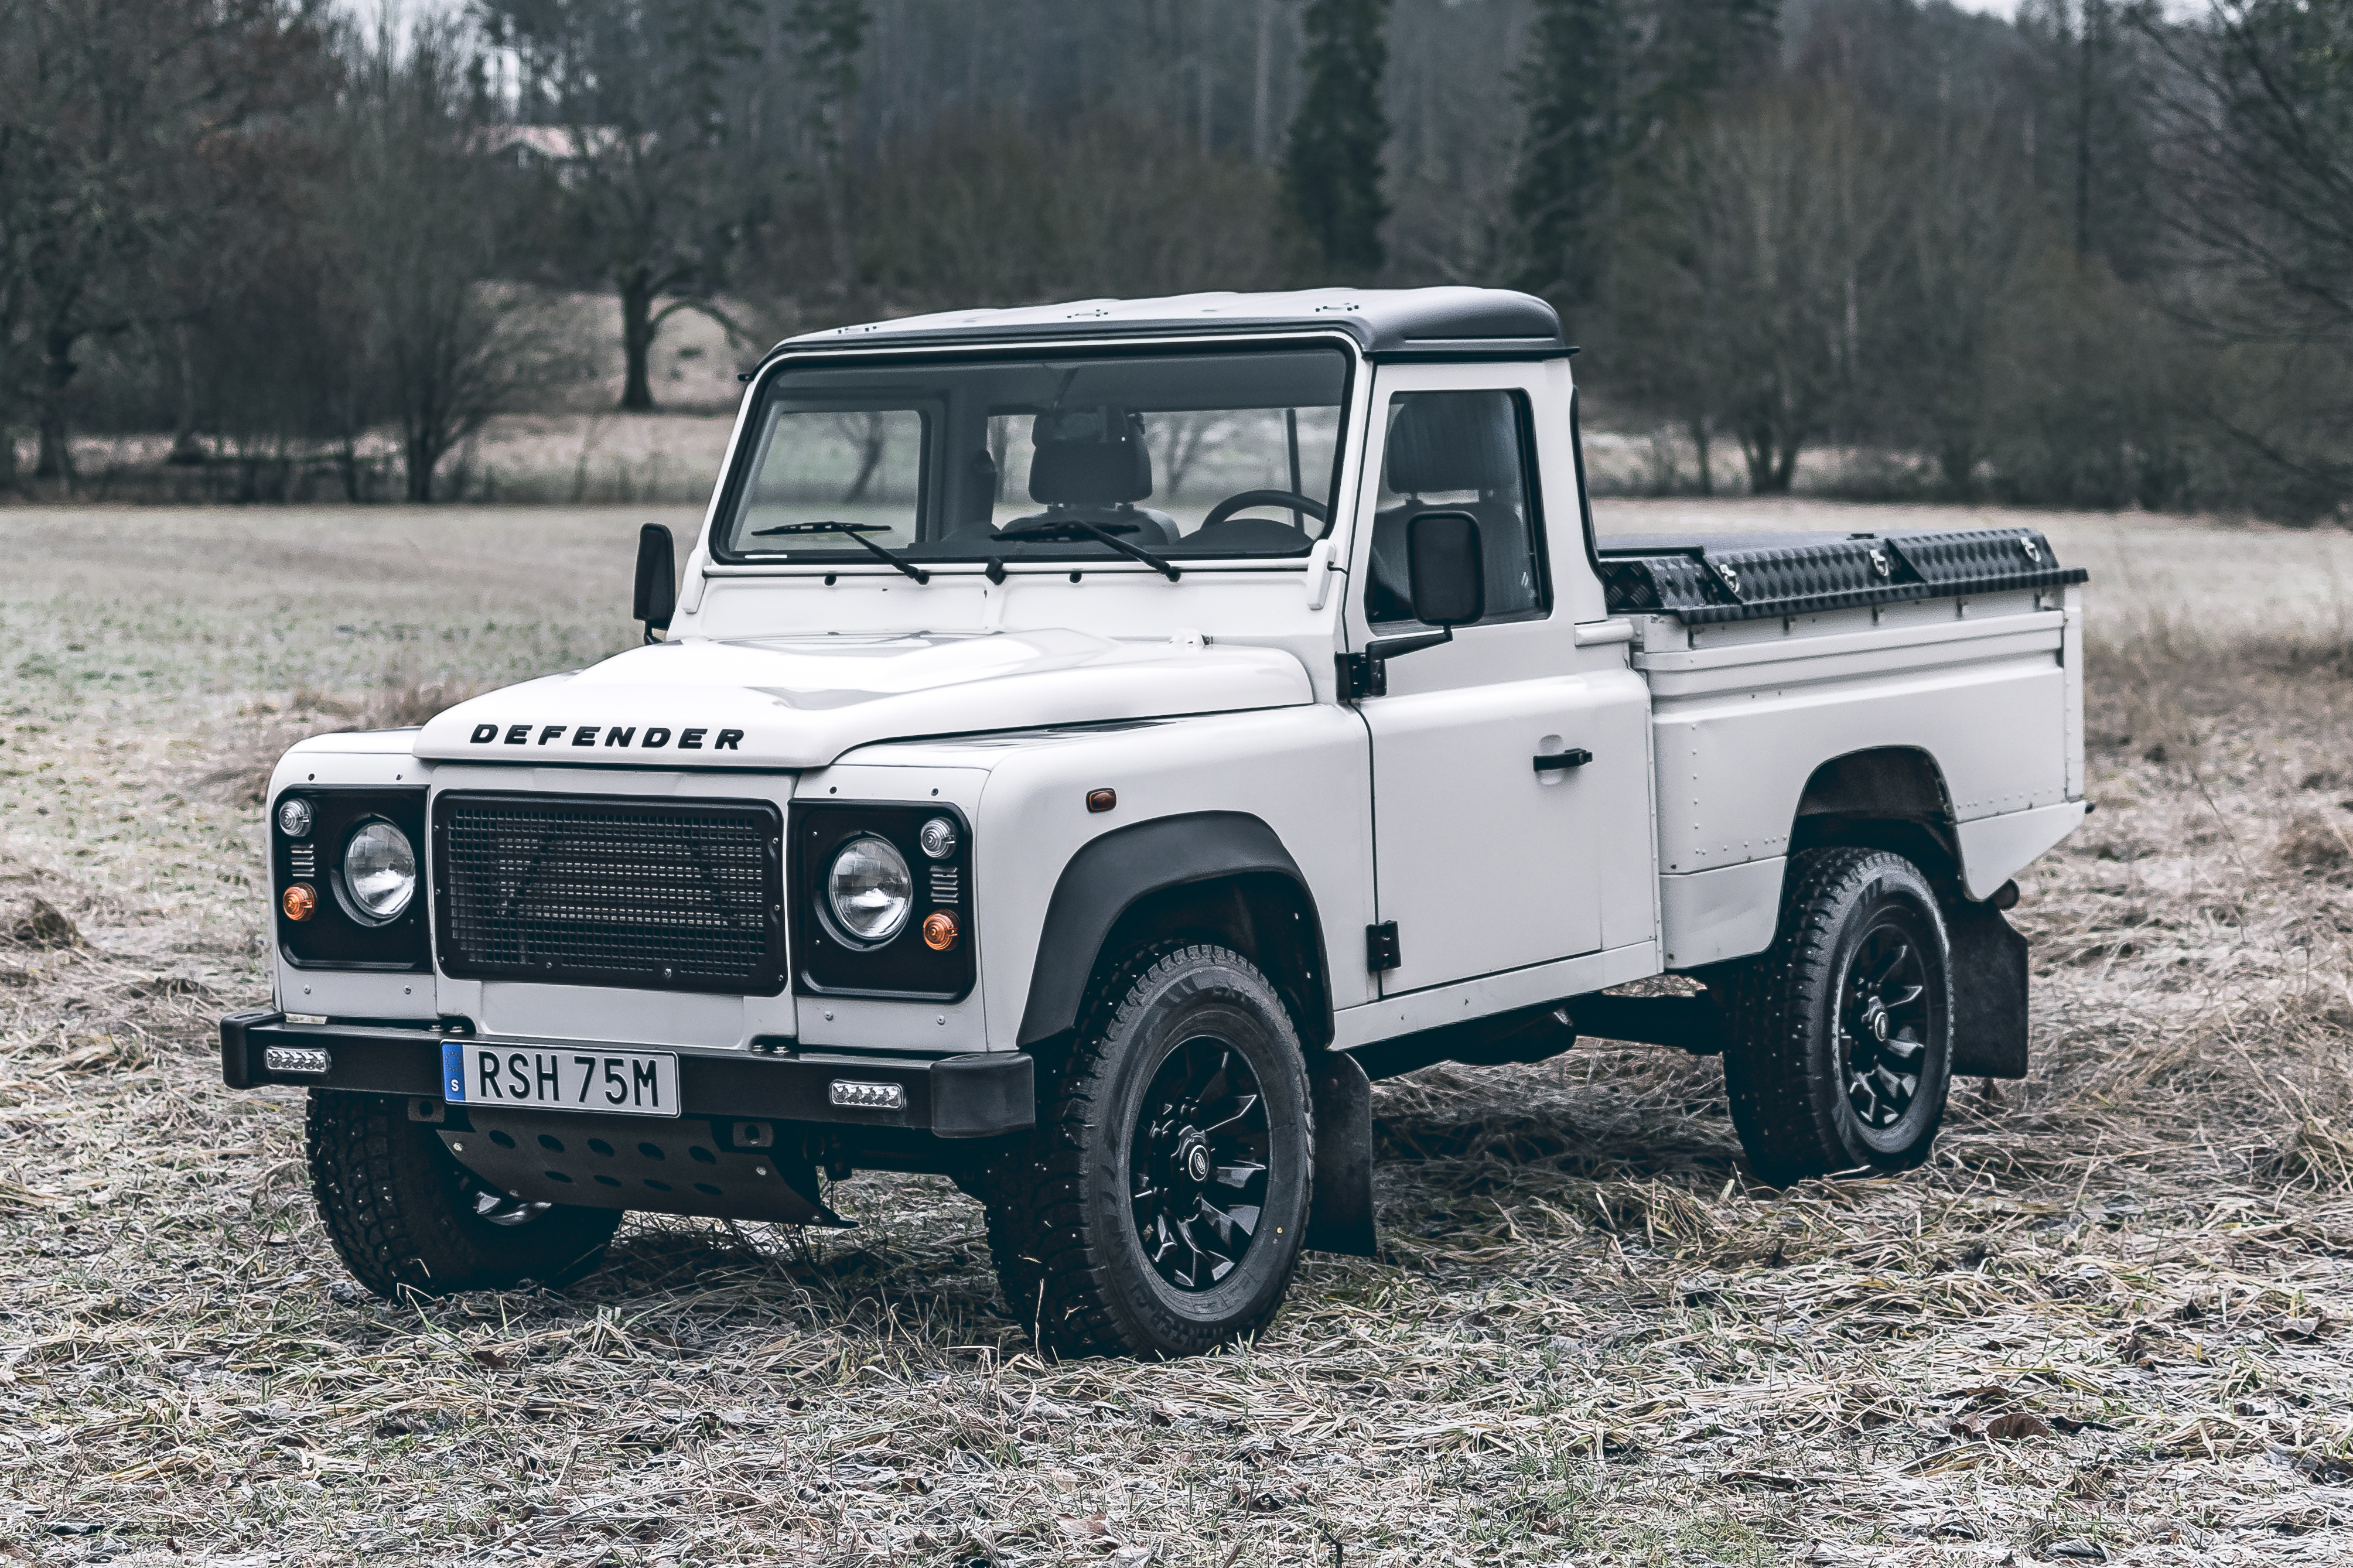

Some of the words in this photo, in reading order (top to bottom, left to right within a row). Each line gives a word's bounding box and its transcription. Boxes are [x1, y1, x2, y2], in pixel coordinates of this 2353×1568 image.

[469, 723, 745, 750] DEFENDER
[451, 1079, 459, 1092] S
[478, 1051, 561, 1102] RSH
[573, 1056, 660, 1108] 75M
